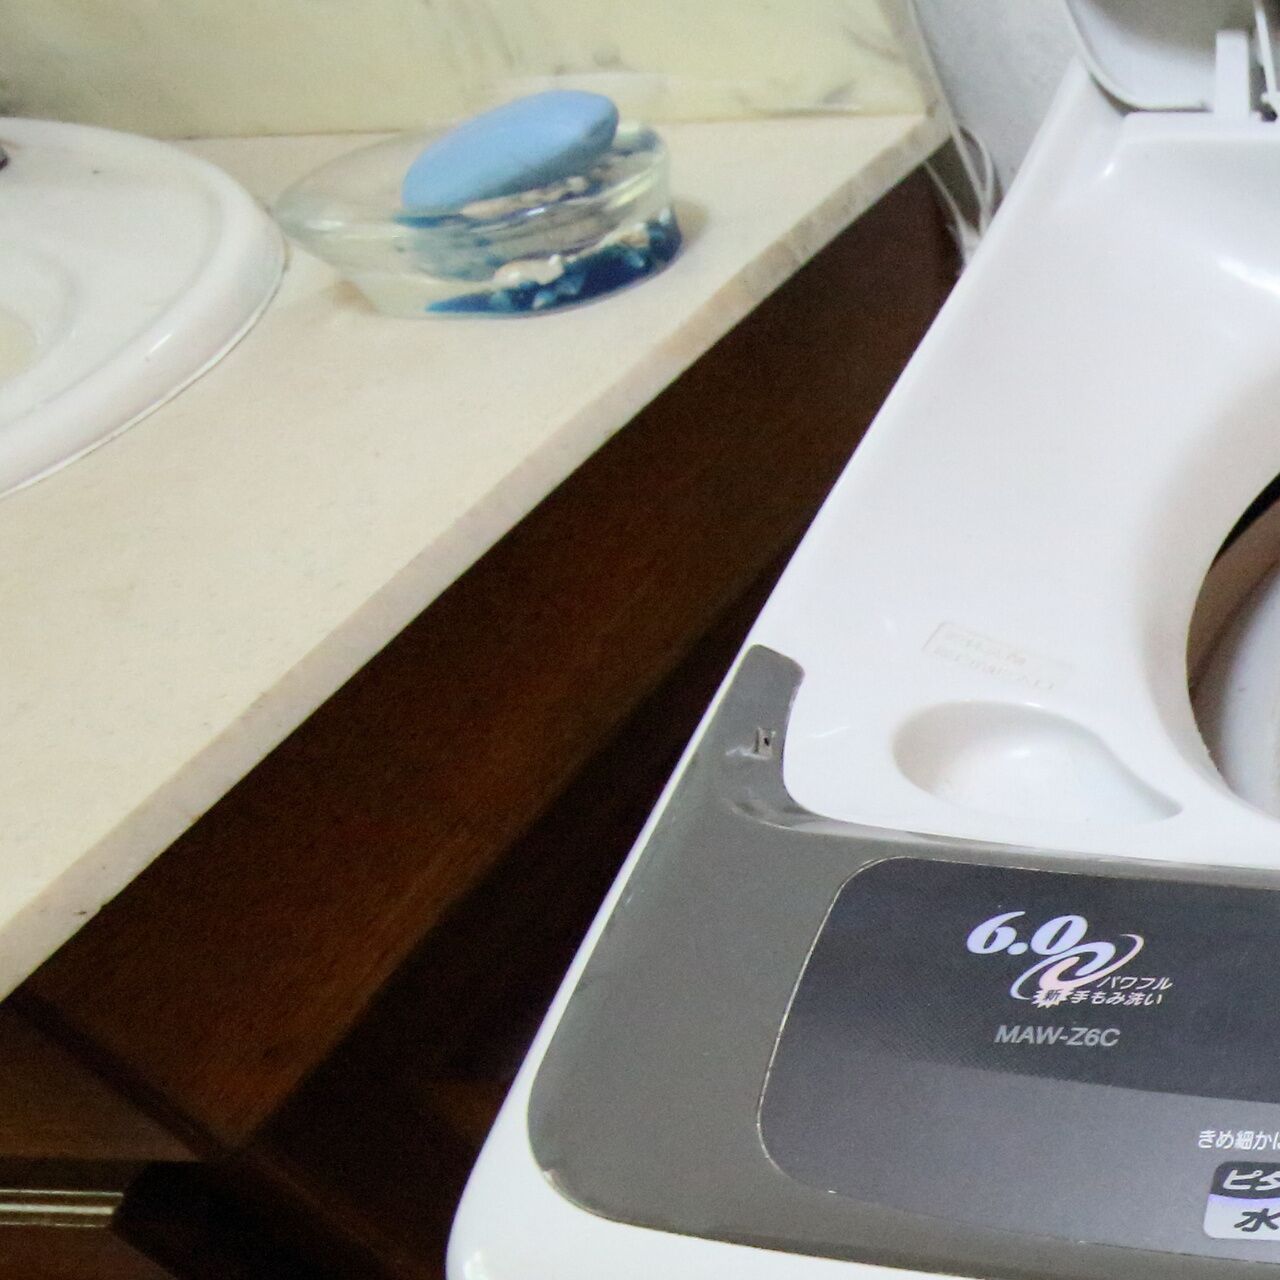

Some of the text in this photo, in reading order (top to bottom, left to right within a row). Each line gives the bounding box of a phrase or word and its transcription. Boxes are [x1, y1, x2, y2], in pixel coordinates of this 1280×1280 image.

[966, 910, 1089, 956] 6.0
[1096, 975, 1174, 990] パワフル
[1070, 989, 1162, 1006] 手もみ洗い
[994, 1024, 1121, 1047] MAW-Z6C
